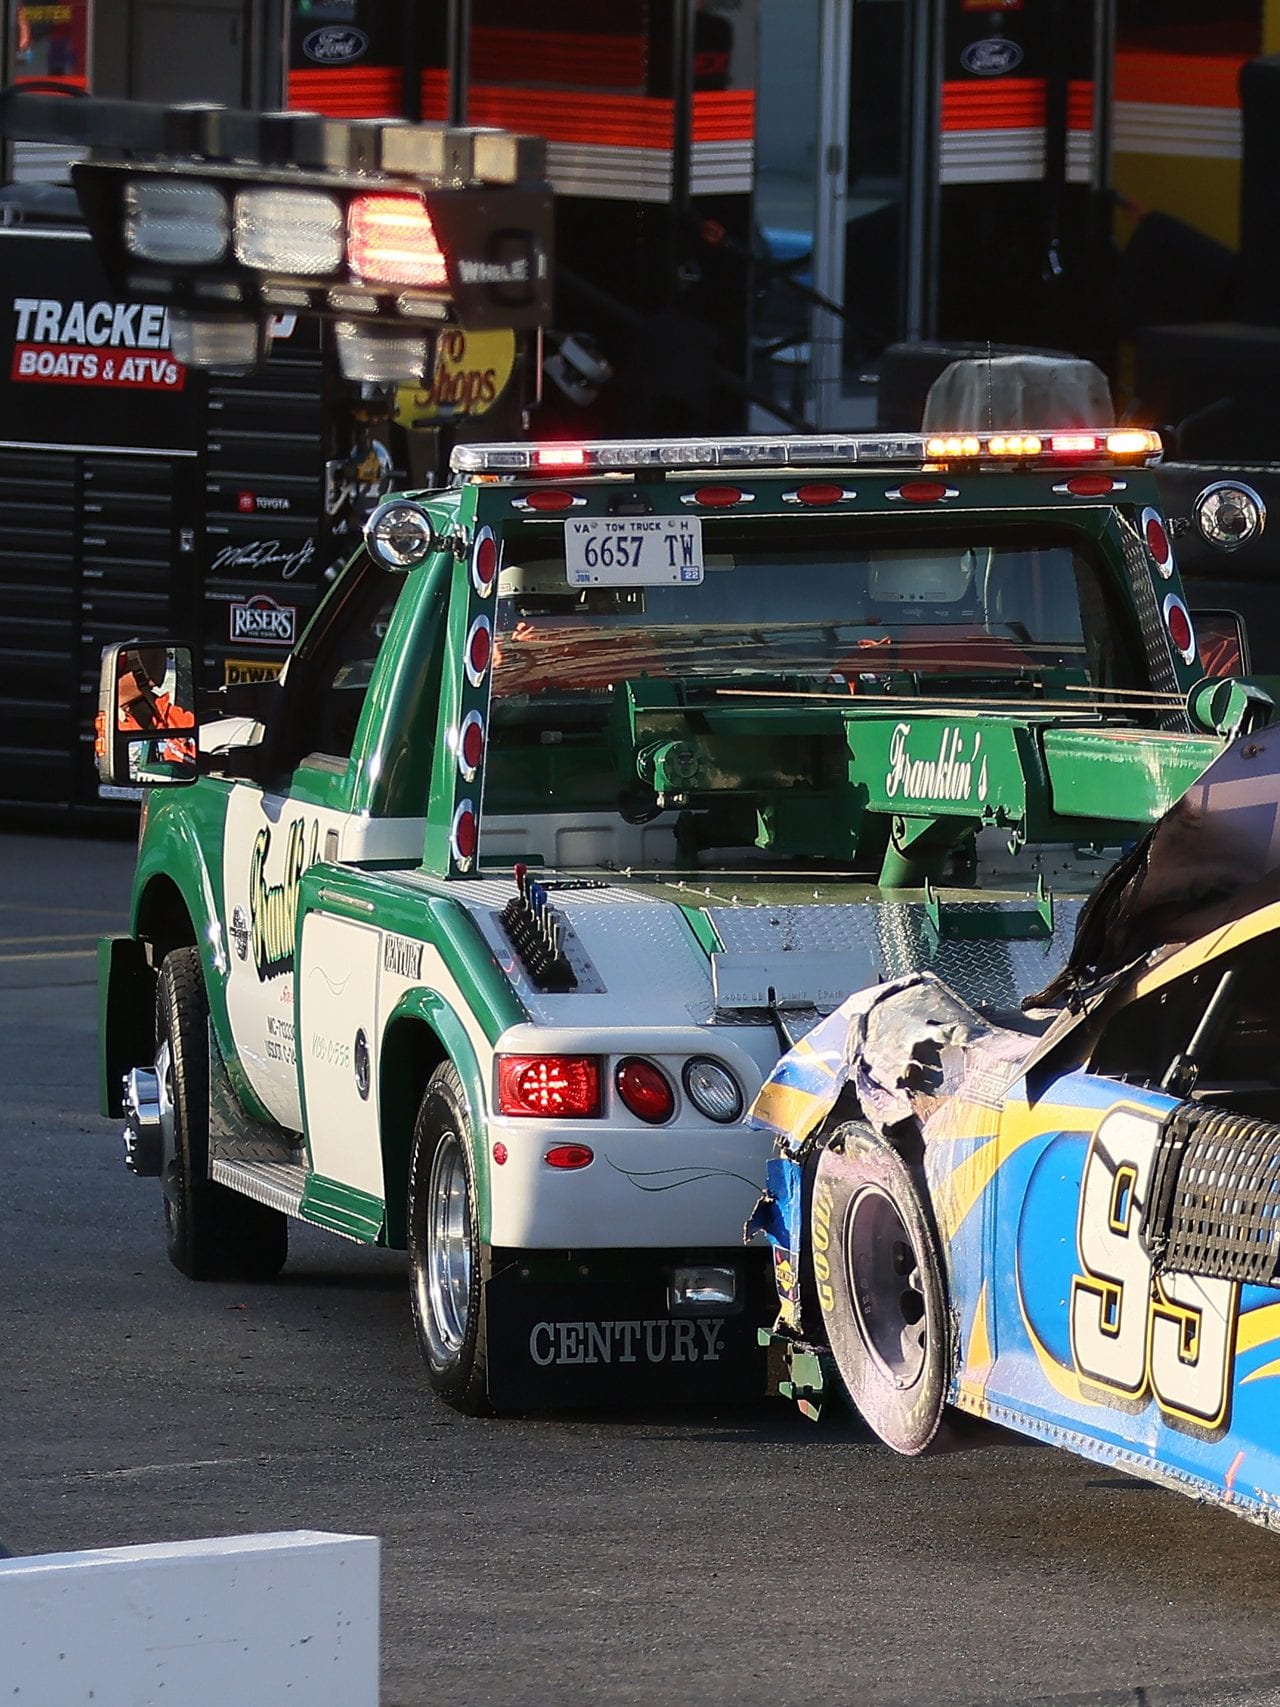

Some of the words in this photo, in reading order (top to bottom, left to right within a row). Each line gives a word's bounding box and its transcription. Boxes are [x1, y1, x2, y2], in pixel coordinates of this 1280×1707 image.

[13, 297, 171, 349] TRACKE
[19, 350, 98, 378] BOATS
[102, 359, 115, 381] &
[119, 355, 177, 385] ATVs
[255, 497, 291, 510] TOYOTA
[573, 523, 591, 533] VA
[605, 523, 625, 532] TOW
[630, 522, 662, 531] TRUCK
[681, 521, 689, 530] H
[584, 536, 645, 568] 6657
[664, 534, 694, 567] TW
[684, 571, 699, 580] 22
[885, 722, 988, 802] Franklin's
[1069, 1099, 1243, 1431] 99
[529, 1318, 726, 1366] CENTURY
